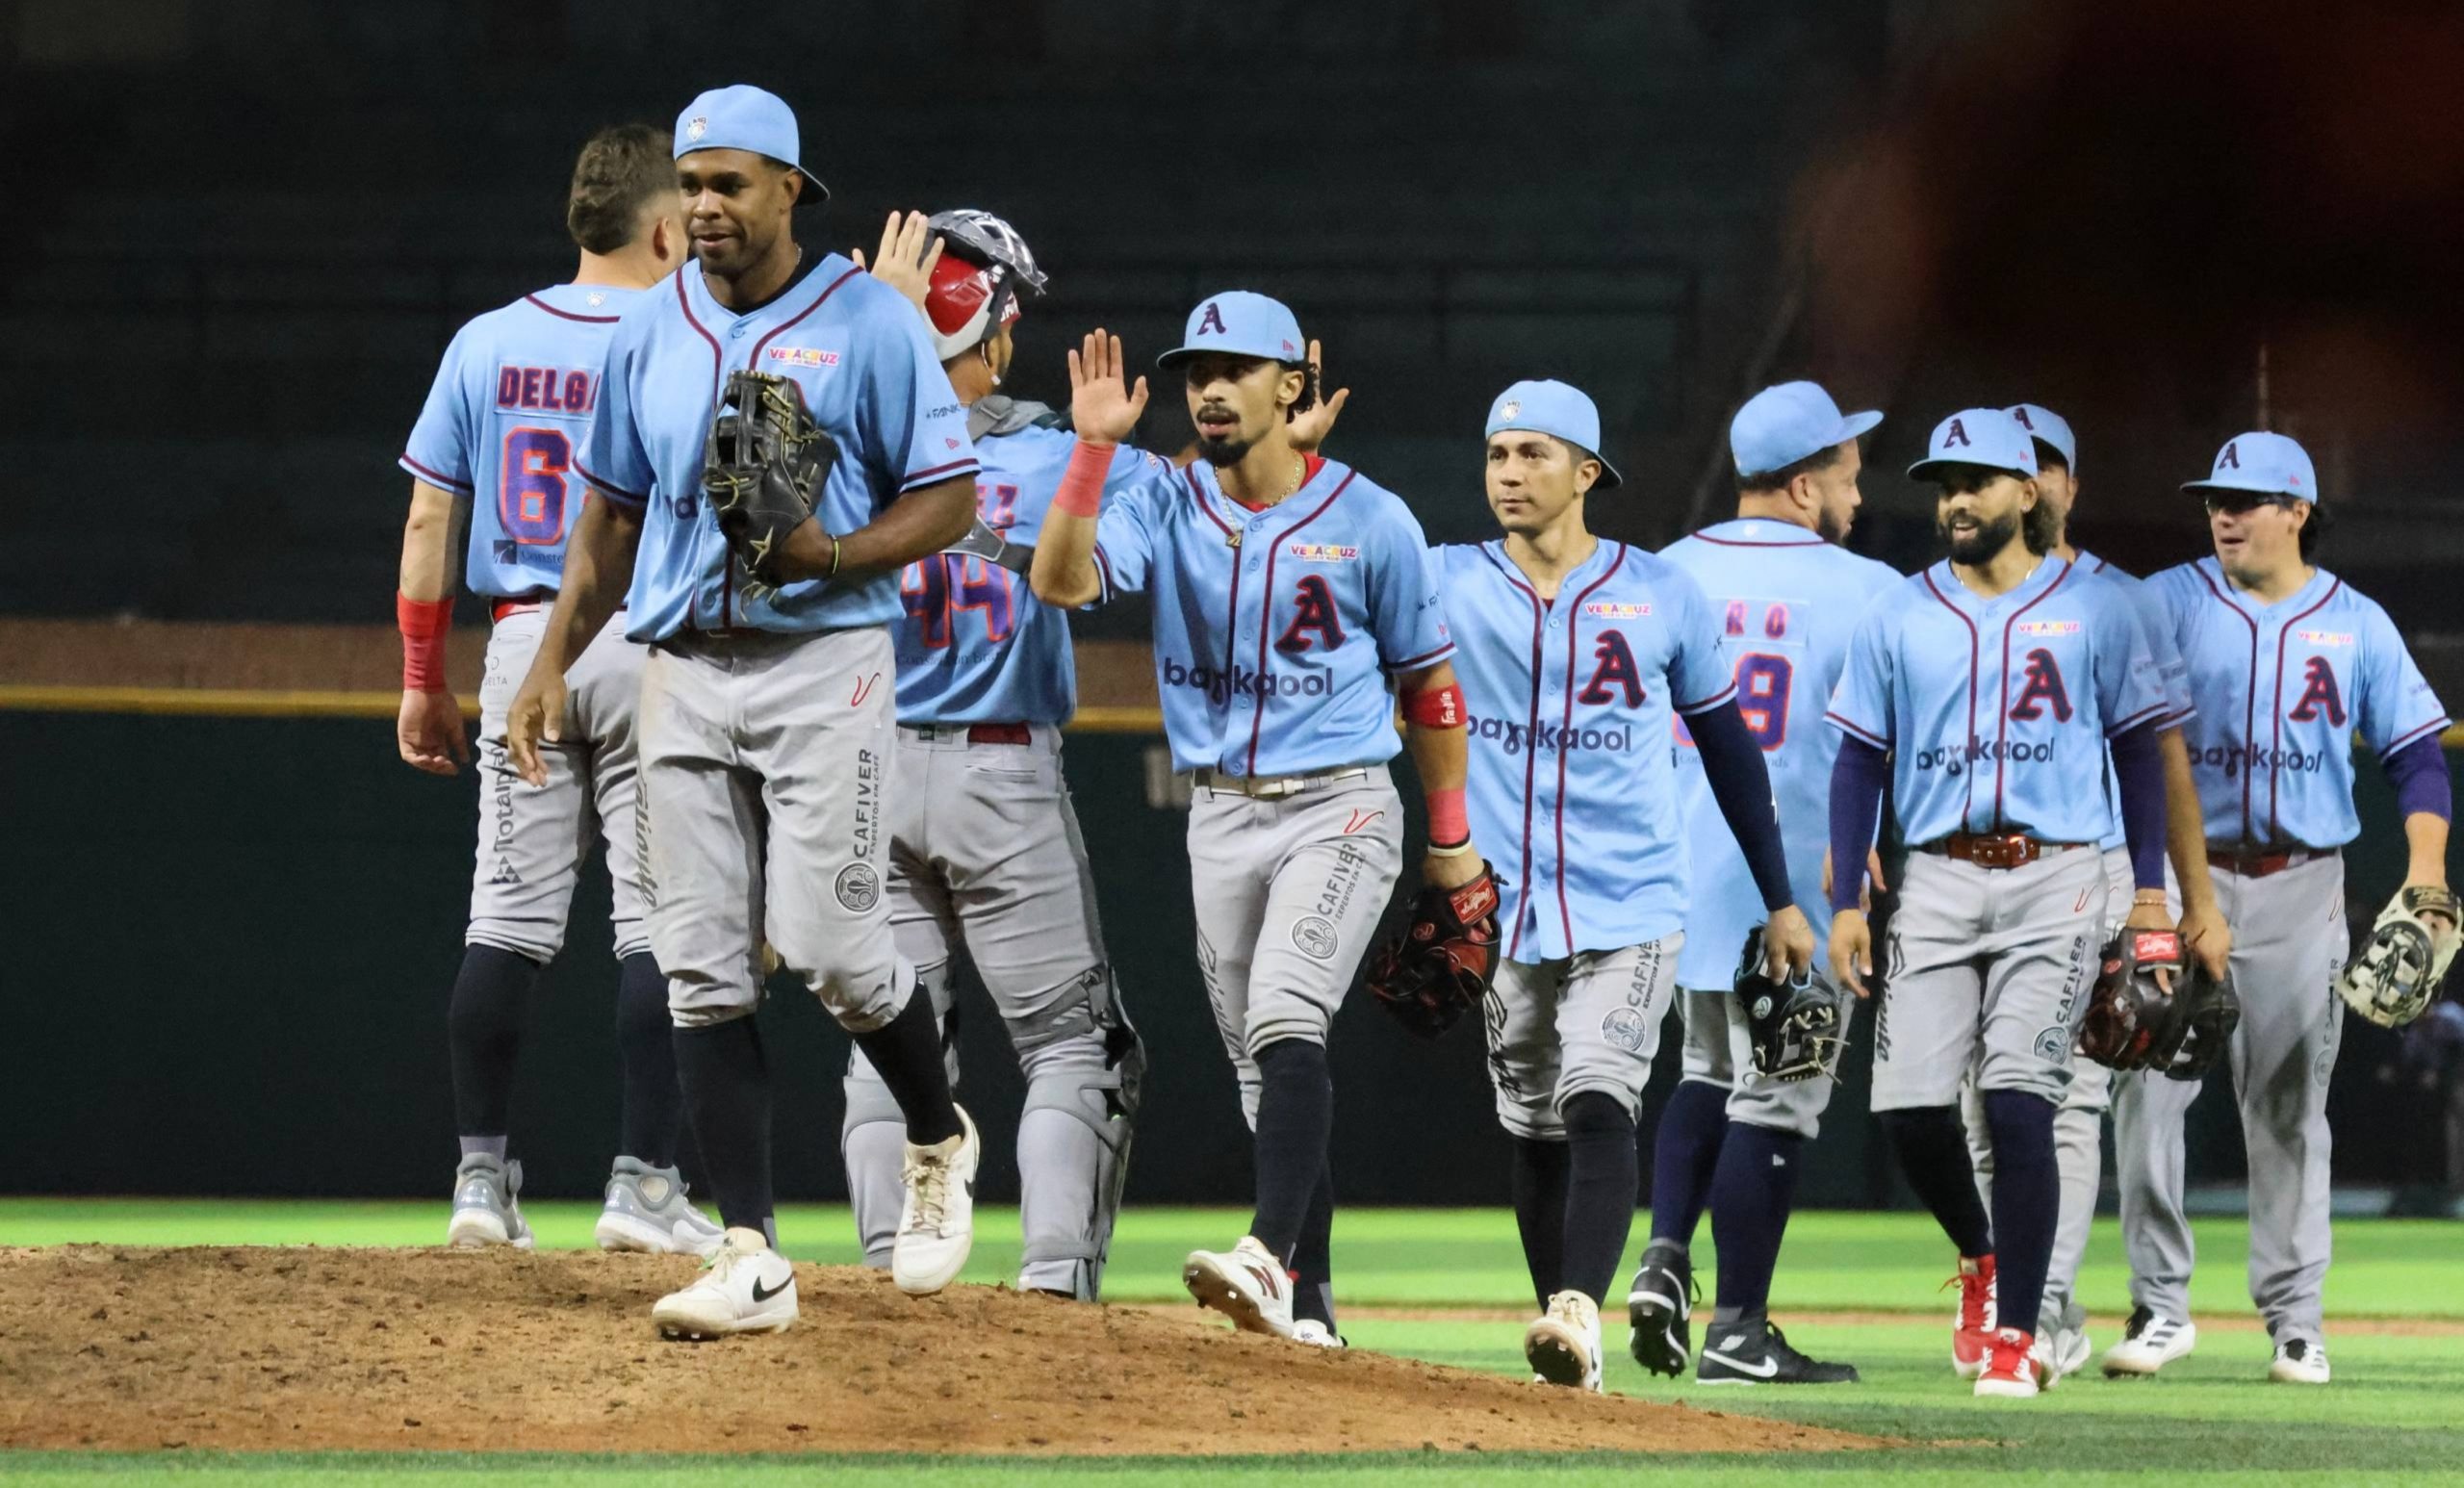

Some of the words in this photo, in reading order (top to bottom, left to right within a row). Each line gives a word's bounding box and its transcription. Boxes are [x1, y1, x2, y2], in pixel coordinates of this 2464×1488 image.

[1196, 302, 1227, 336] A
[1942, 418, 1972, 449] A
[2218, 442, 2241, 471] A
[500, 424, 572, 547] 6
[1290, 545, 1356, 557] VERACRUZ
[1272, 574, 1348, 654] A
[1576, 629, 1648, 710] A
[2007, 647, 2074, 725] A
[2288, 655, 2348, 730] A
[853, 748, 873, 859] CAFIVER
[1317, 843, 1358, 916] CAFIVER
[2056, 936, 2082, 1023] CAFIVER
